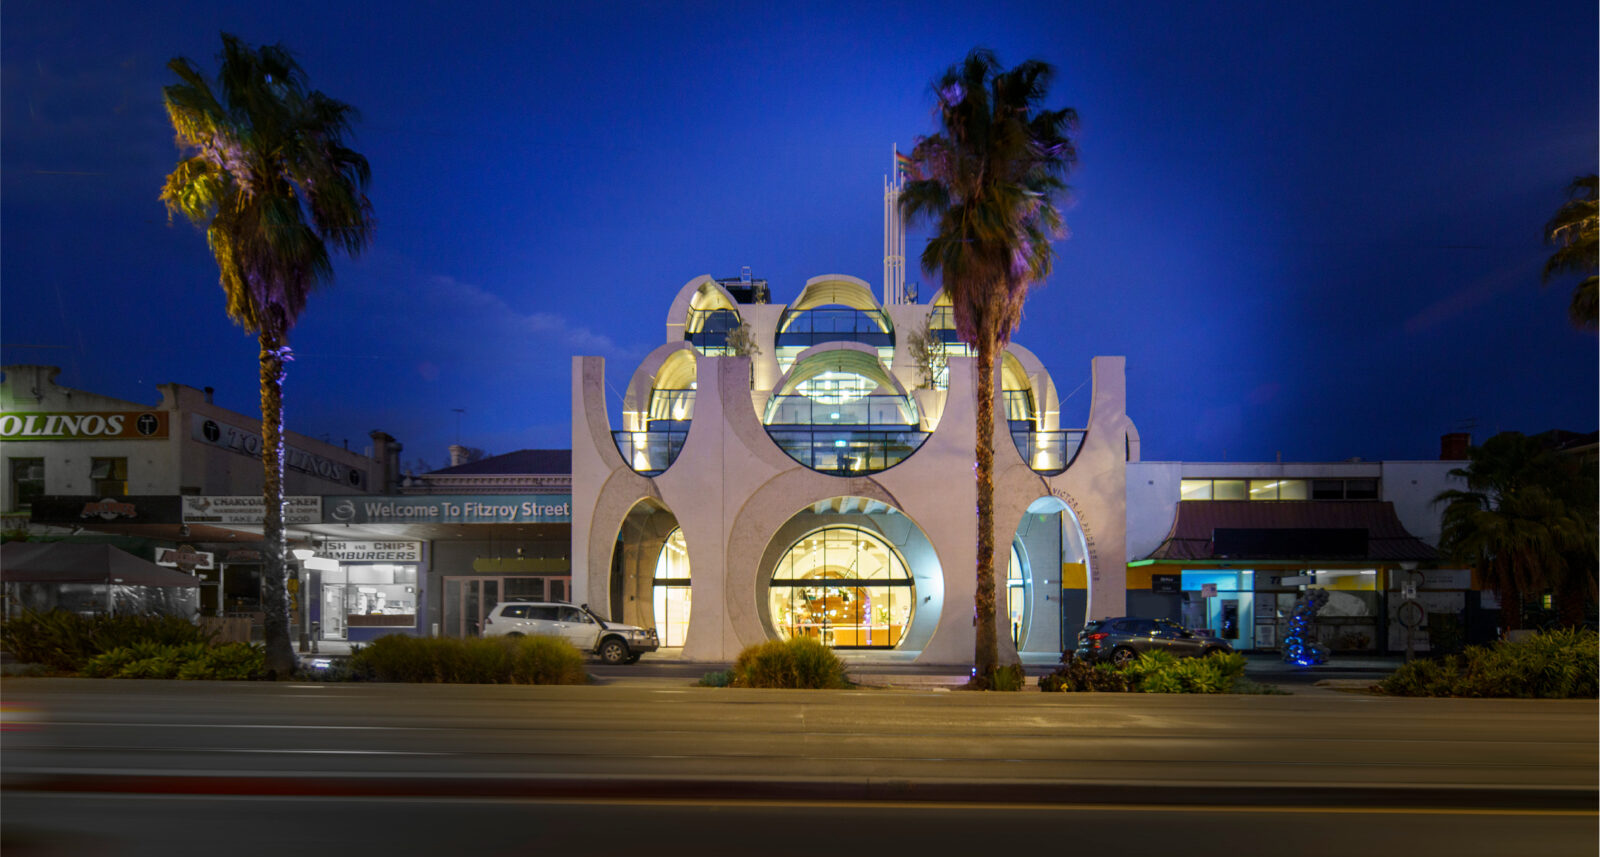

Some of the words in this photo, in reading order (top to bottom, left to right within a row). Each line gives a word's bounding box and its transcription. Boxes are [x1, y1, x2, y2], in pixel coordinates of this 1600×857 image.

[0, 414, 125, 436] OLINOS
[228, 429, 341, 480] TOLINOS
[214, 498, 265, 506] CHARCOA
[289, 498, 318, 506] CKEN
[1053, 487, 1085, 521] VICTORAN
[365, 502, 439, 517] Welcome
[442, 502, 461, 517] To
[464, 502, 518, 521] Fitzroy
[521, 502, 570, 517] Street
[323, 542, 346, 550] ISH
[374, 542, 415, 550] CHIPS
[313, 551, 416, 560] HAMBURGERS
